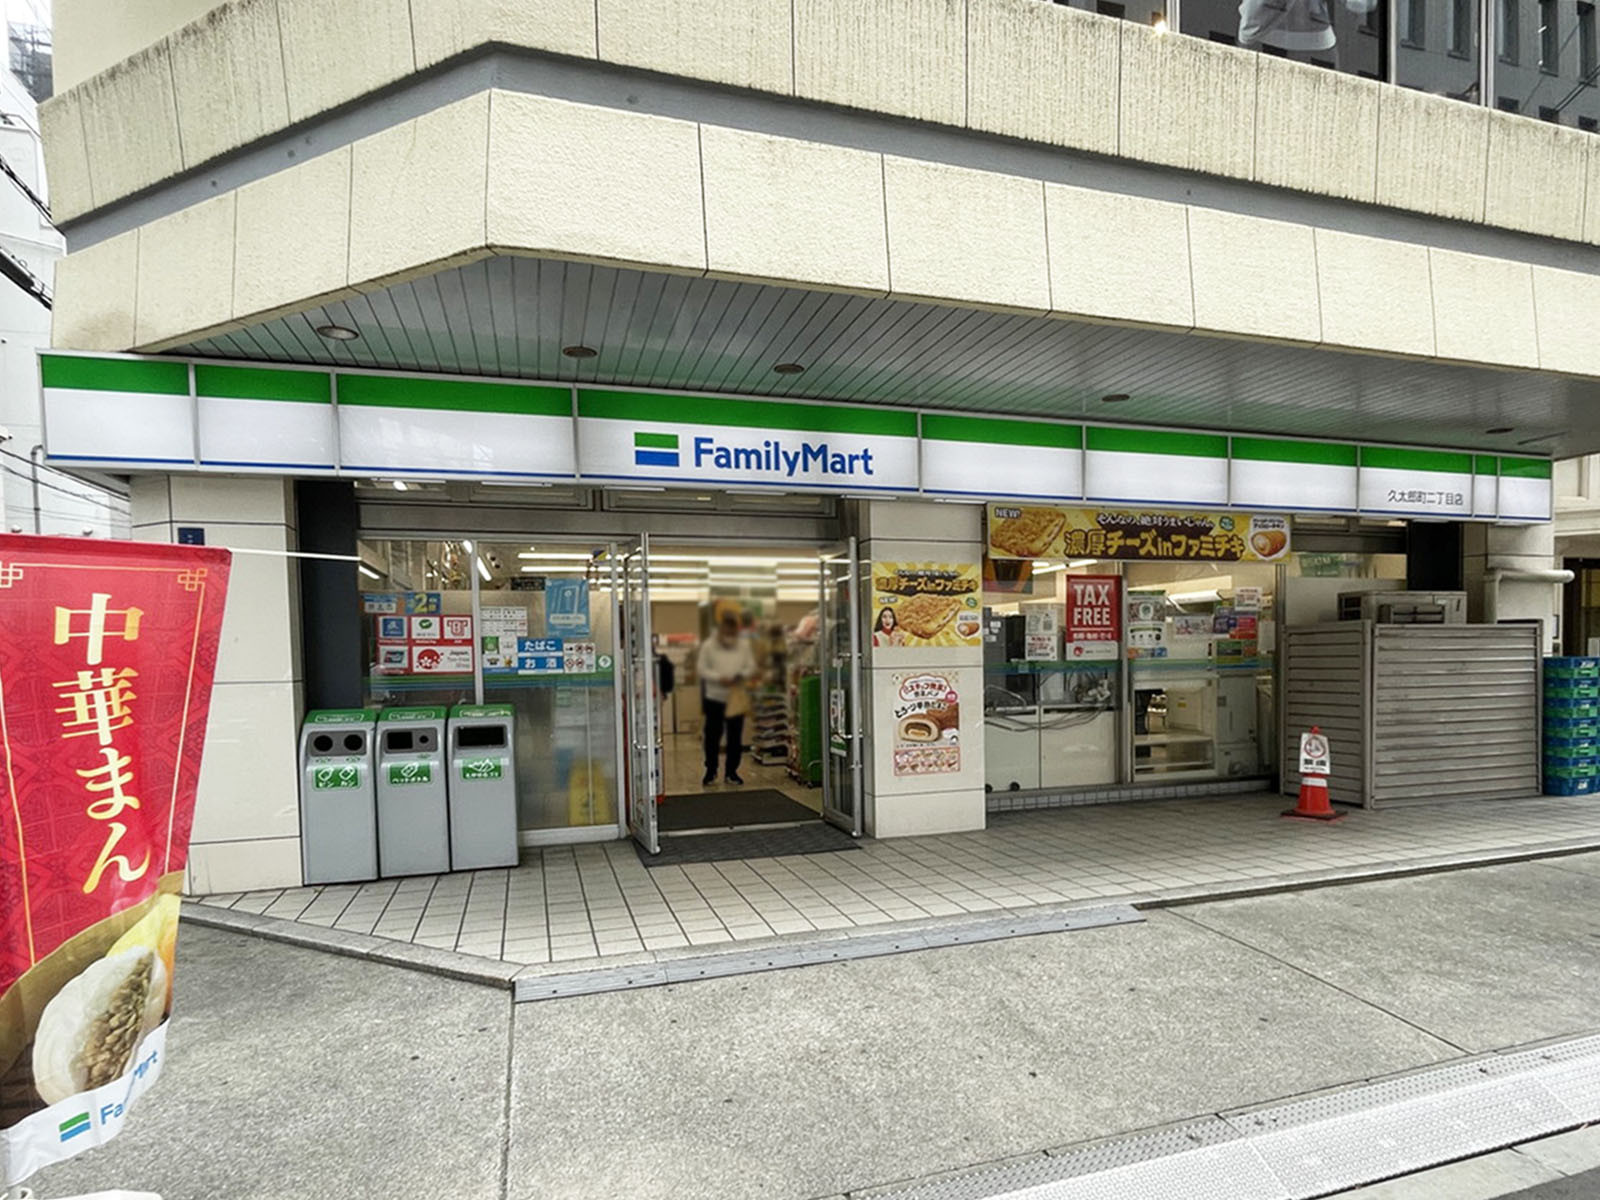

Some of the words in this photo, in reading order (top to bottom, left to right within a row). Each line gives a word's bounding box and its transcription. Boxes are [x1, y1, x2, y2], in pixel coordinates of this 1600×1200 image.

[694, 437, 874, 477] FamilyMart
[1073, 584, 1110, 606] TAX
[1073, 607, 1111, 626] FREE
[524, 640, 557, 652] たばこ
[52, 592, 151, 894] 中華まん
